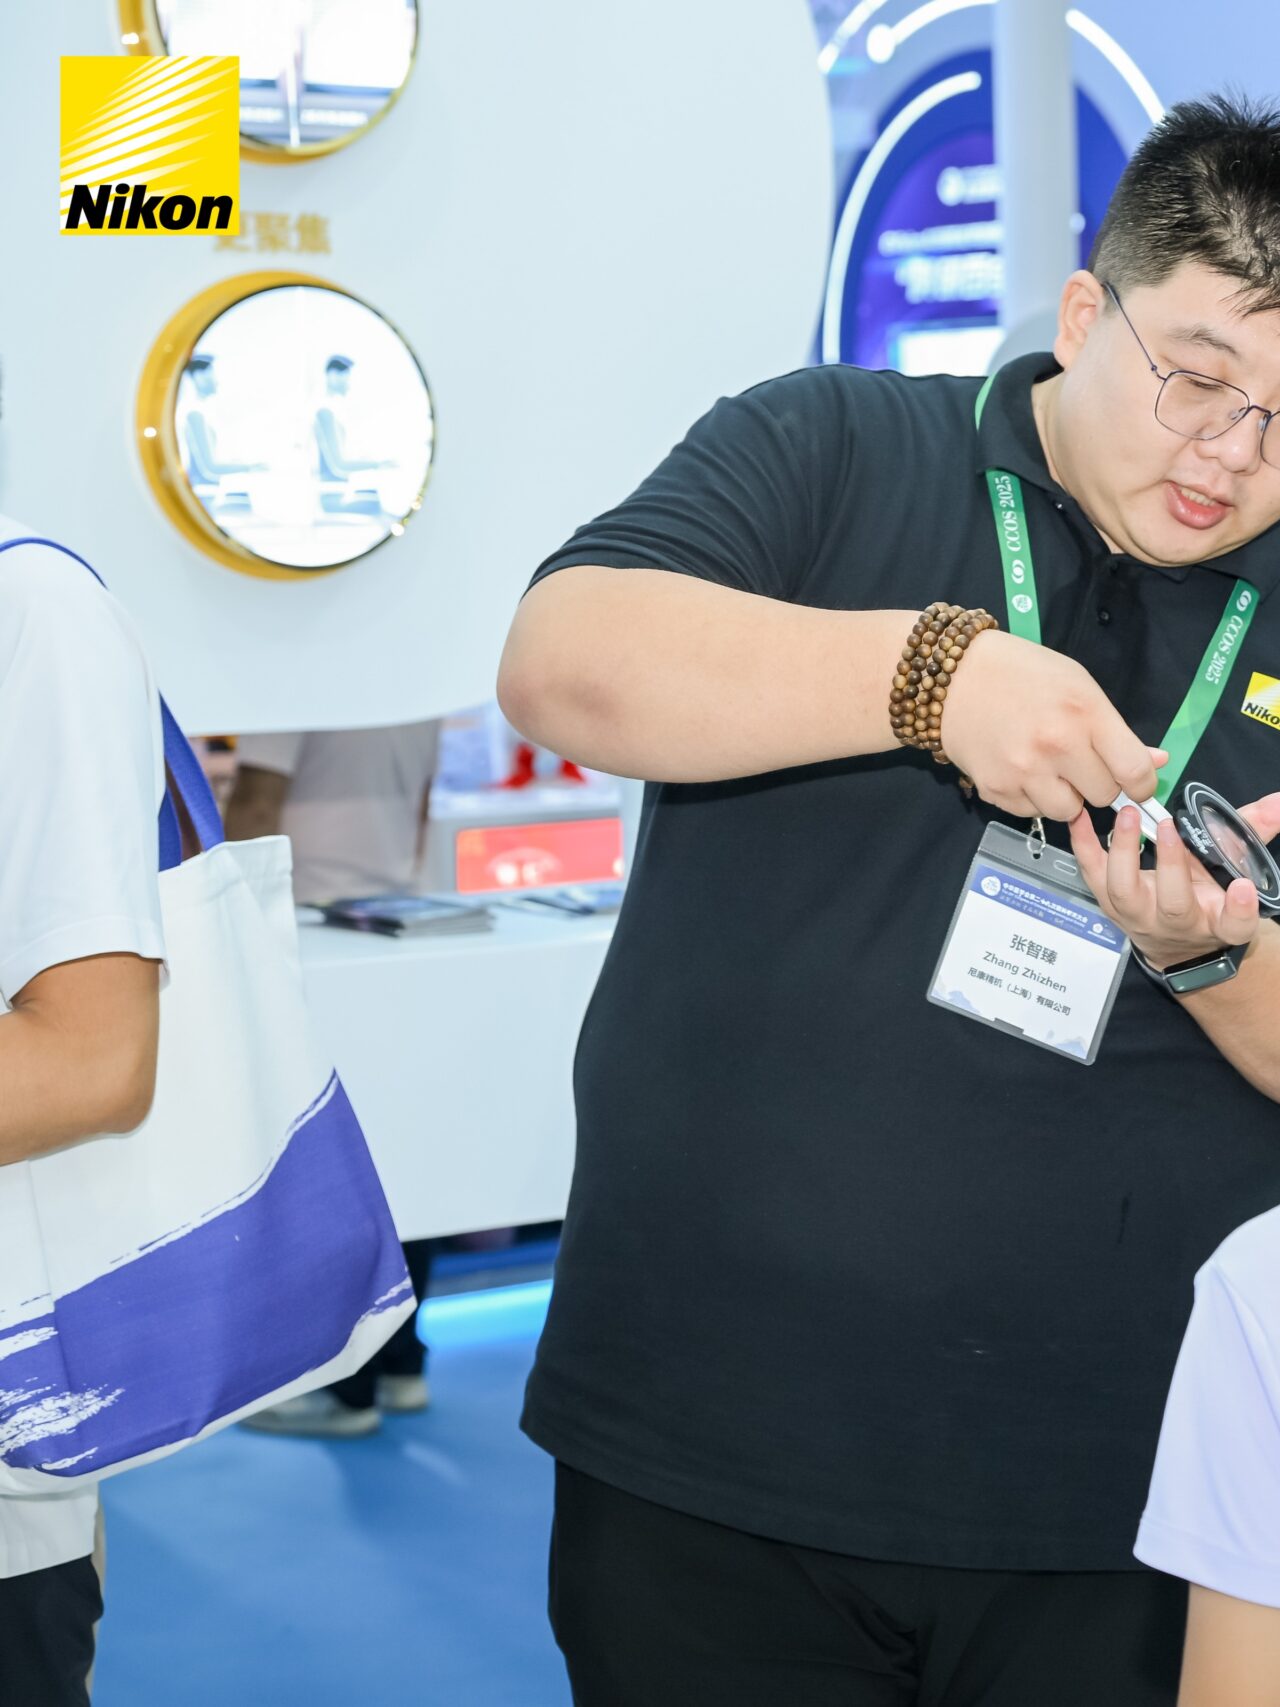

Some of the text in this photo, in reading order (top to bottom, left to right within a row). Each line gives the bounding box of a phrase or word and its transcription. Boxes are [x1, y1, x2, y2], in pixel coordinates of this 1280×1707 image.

[994, 475, 1021, 552] CCOS 2025
[1205, 615, 1244, 685] CCOS 2025
[983, 951, 1067, 993] Zhang Zhizhen
